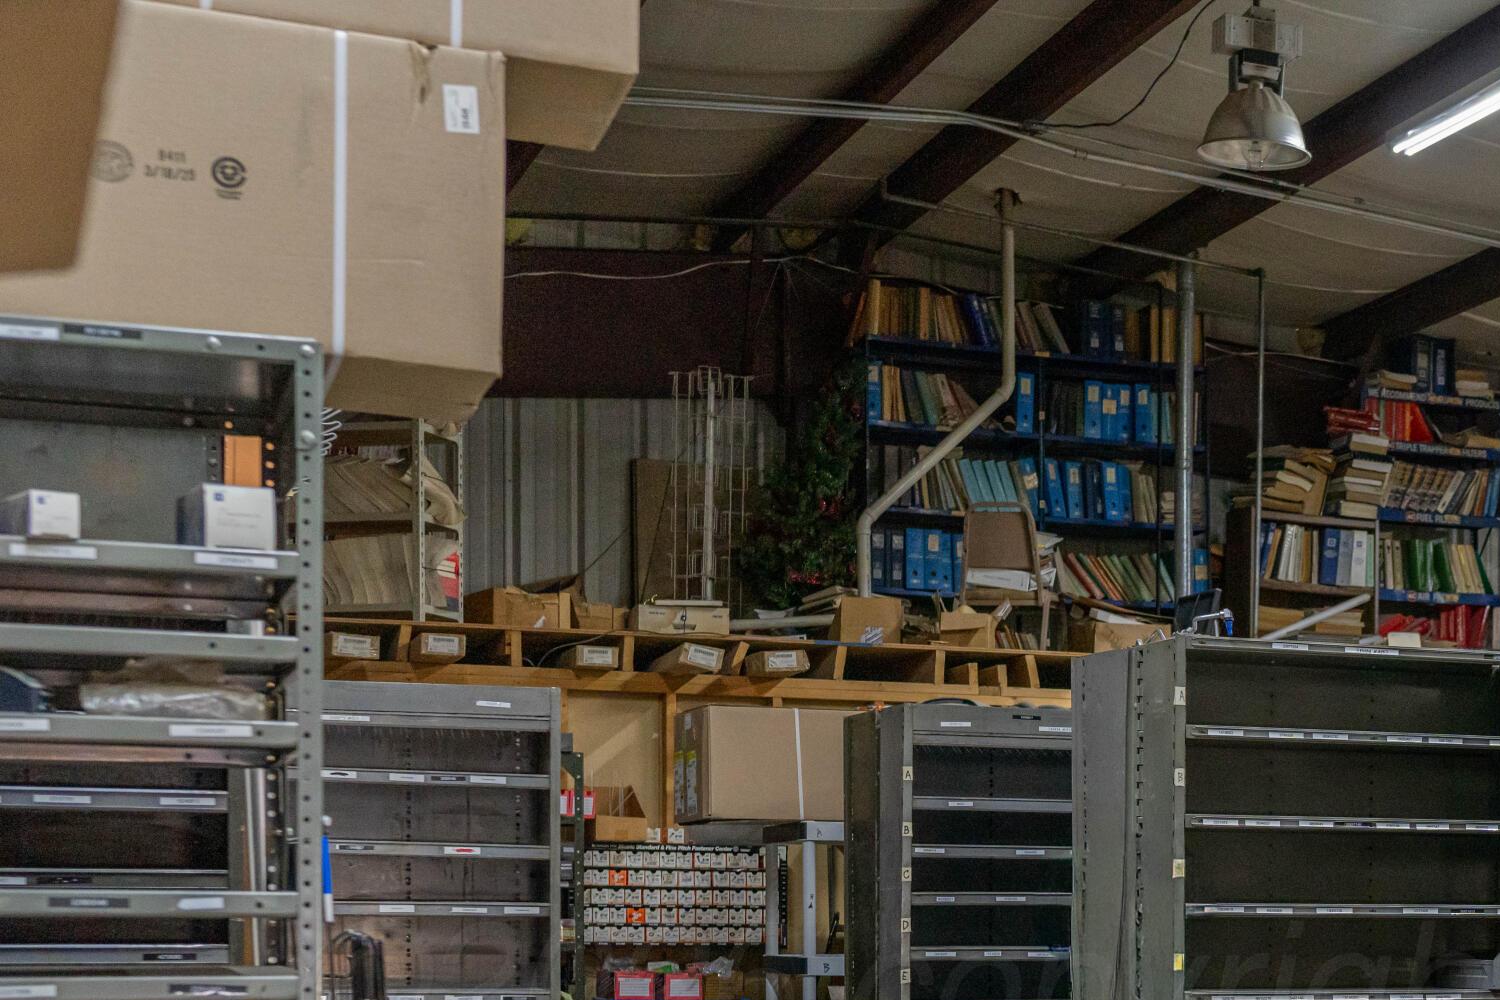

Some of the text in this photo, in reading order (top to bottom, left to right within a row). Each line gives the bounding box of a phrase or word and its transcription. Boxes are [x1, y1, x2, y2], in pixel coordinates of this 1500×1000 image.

[1179, 690, 1184, 701] A
[905, 771, 912, 780] A
[904, 825, 910, 835] B
[903, 869, 909, 879] C
[902, 920, 909, 930] D
[902, 971, 908, 981] E
